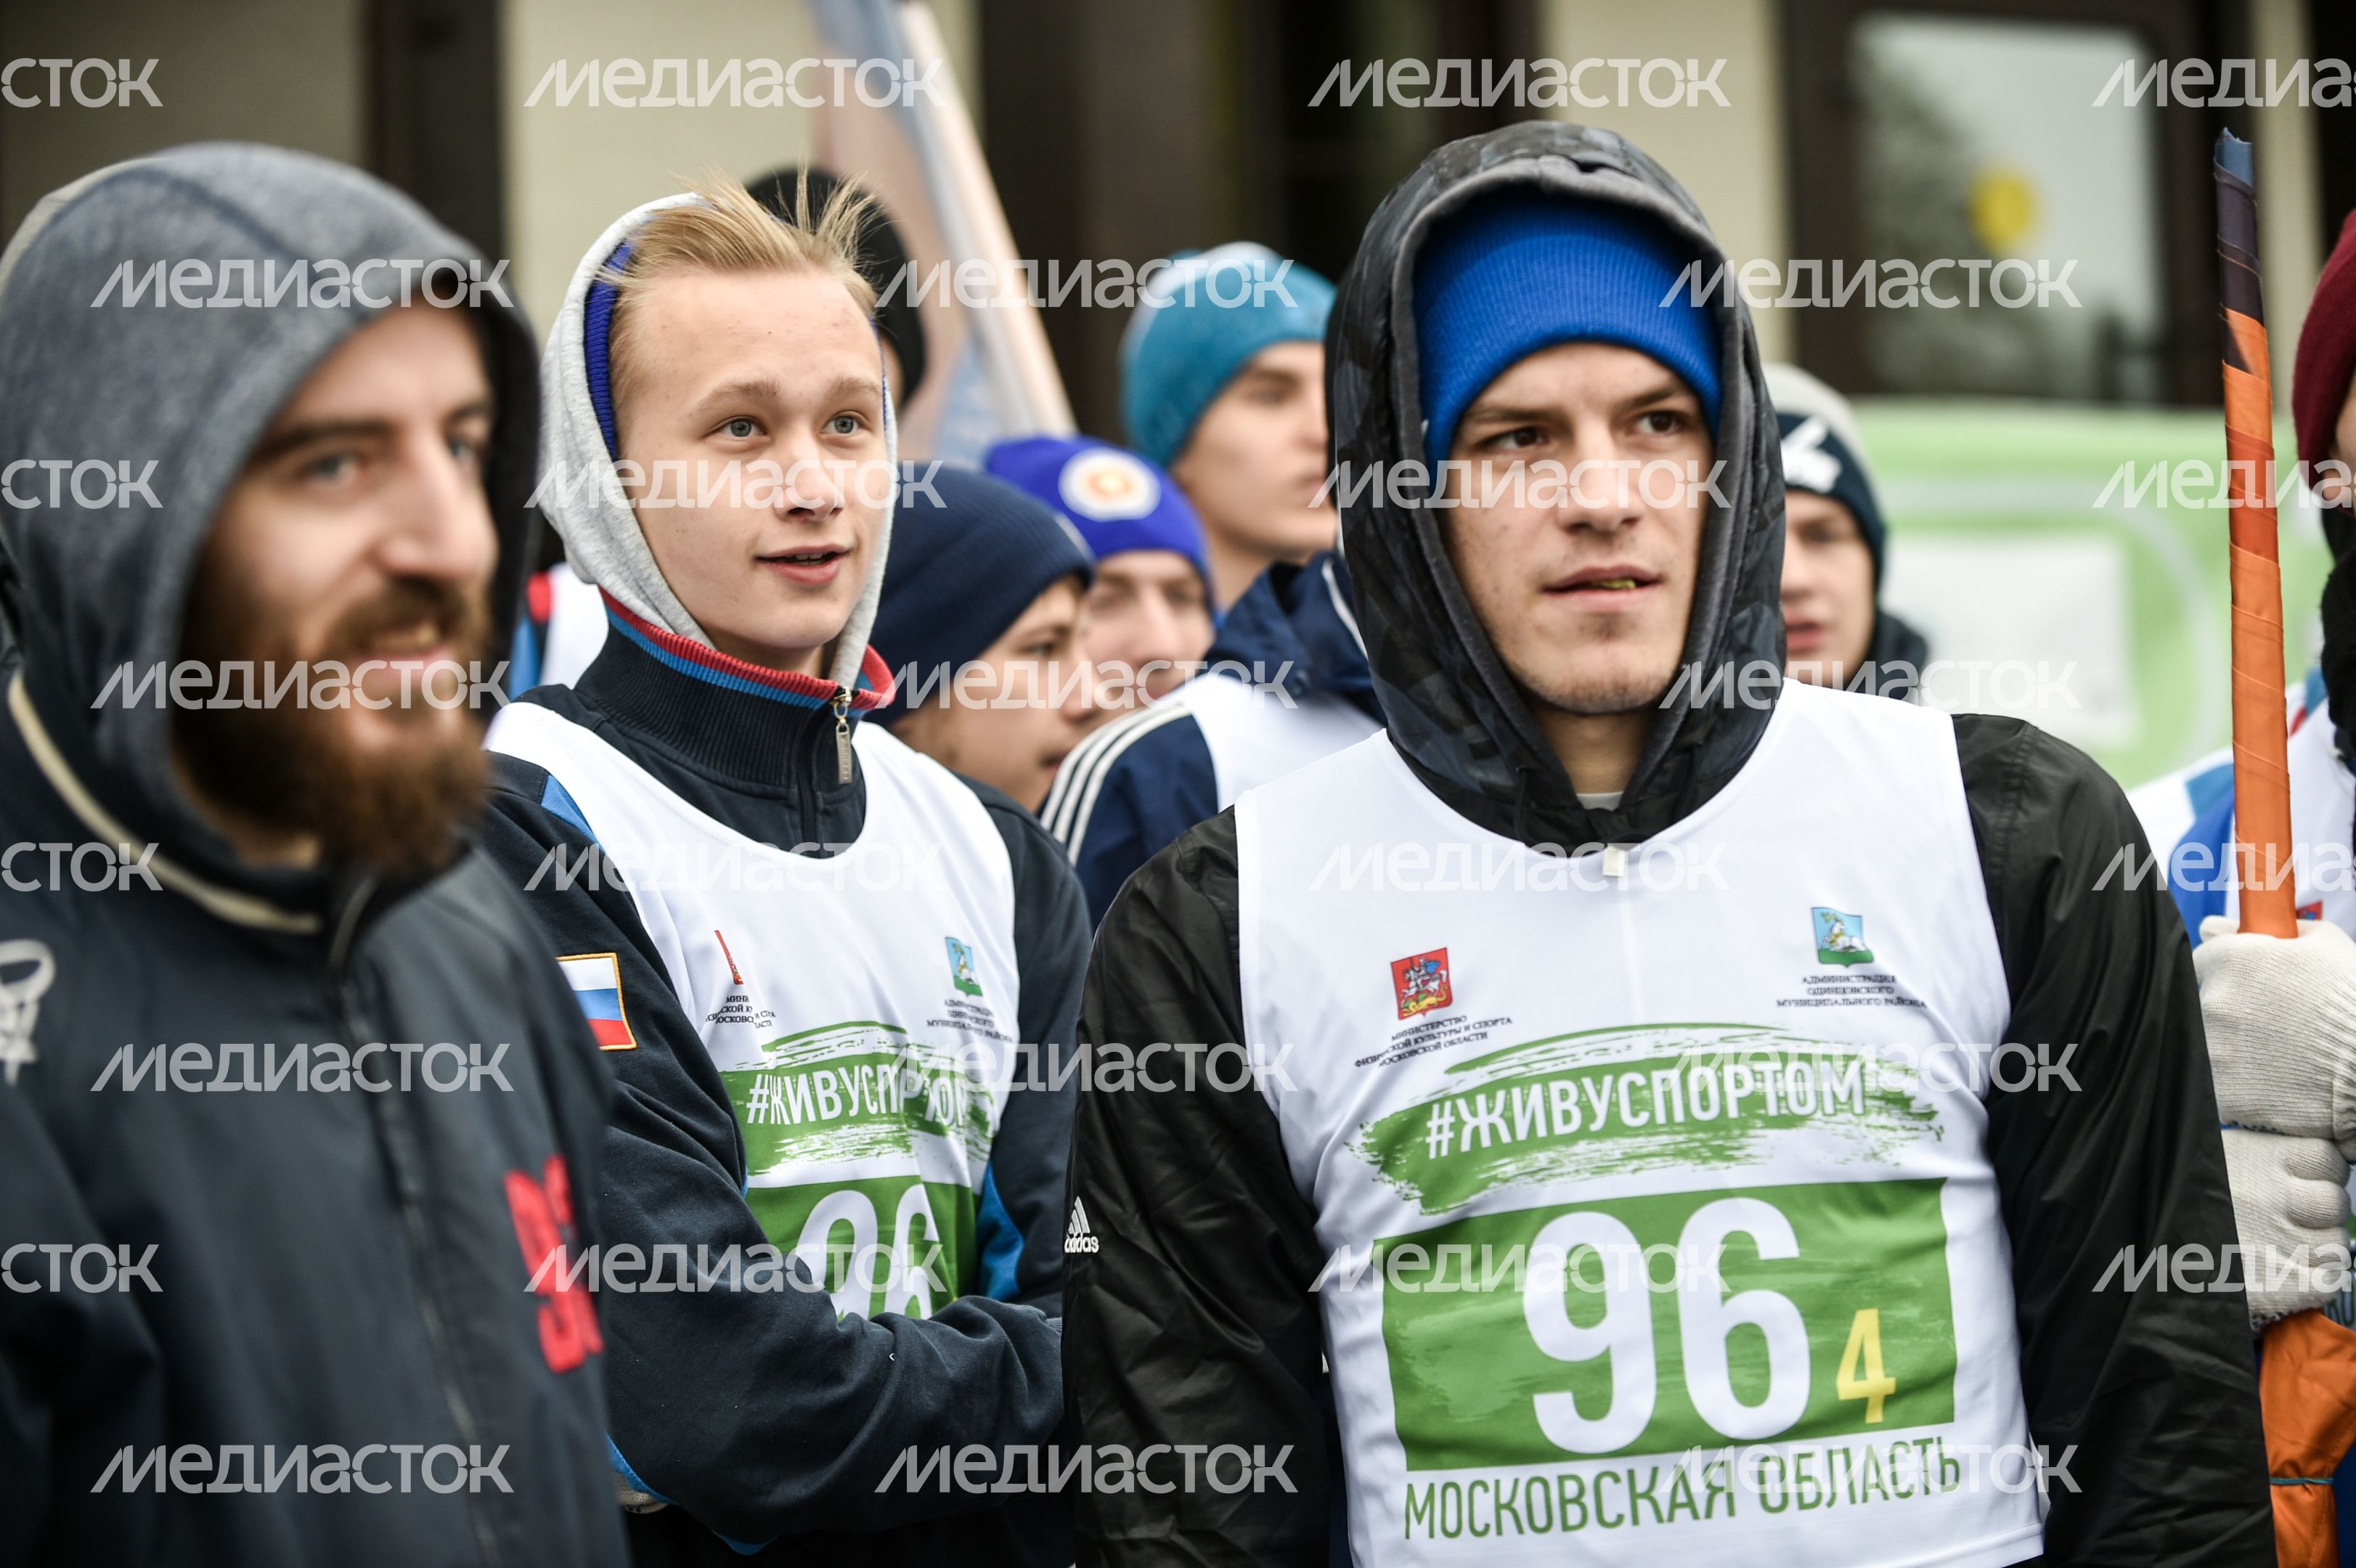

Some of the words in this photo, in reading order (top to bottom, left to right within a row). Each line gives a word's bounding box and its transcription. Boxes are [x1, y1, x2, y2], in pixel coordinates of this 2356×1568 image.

[1424, 1059, 1867, 1161] #ЖИВУСПОРТОМ
[1064, 1231, 1099, 1254] adidas
[1523, 1197, 1811, 1454] 96
[1835, 1308, 1896, 1424] 4
[1403, 1459, 1737, 1540] МОСКОВСКАЯ
[1756, 1436, 1960, 1514] ОБЛАСТЬ
